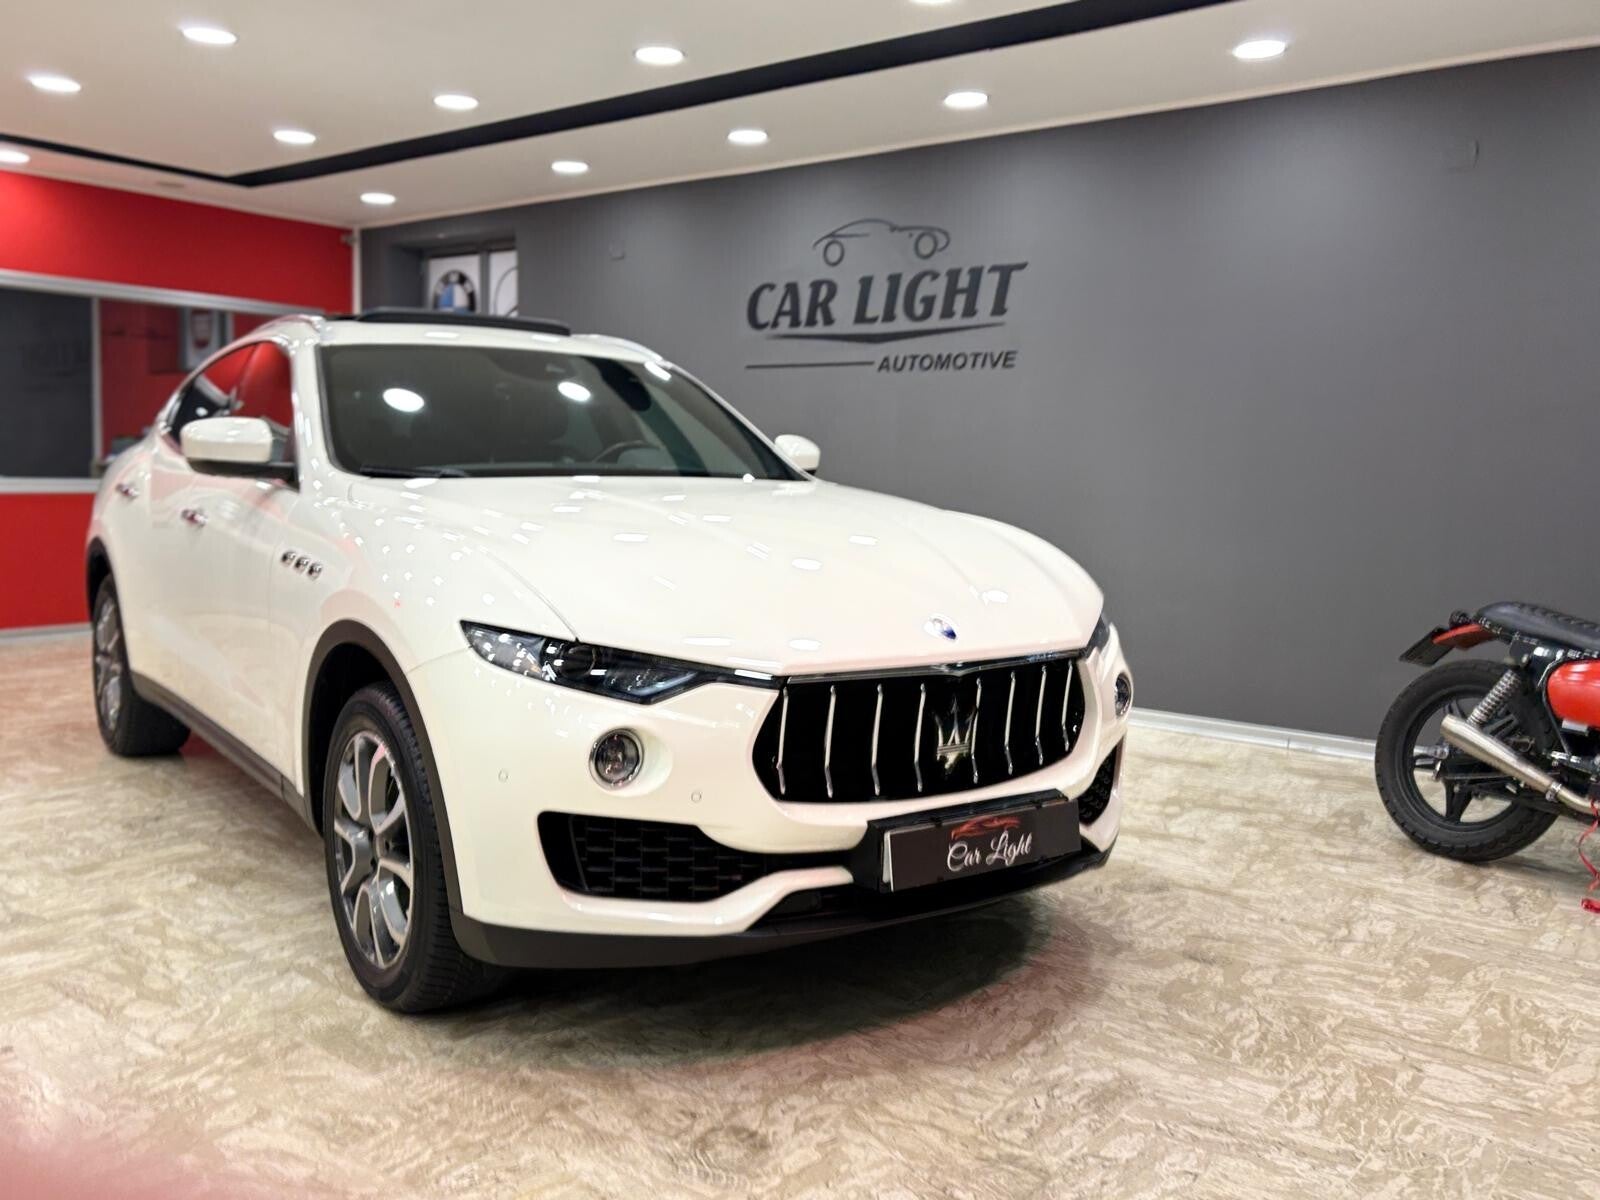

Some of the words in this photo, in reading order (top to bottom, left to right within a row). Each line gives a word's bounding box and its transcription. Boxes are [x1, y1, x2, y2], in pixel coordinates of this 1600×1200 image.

[747, 278, 838, 330] CAR
[853, 261, 1028, 325] LIGHT
[877, 350, 1018, 373] AUTOMOTIVE
[947, 841, 982, 872] Car
[986, 829, 1033, 866] Light
